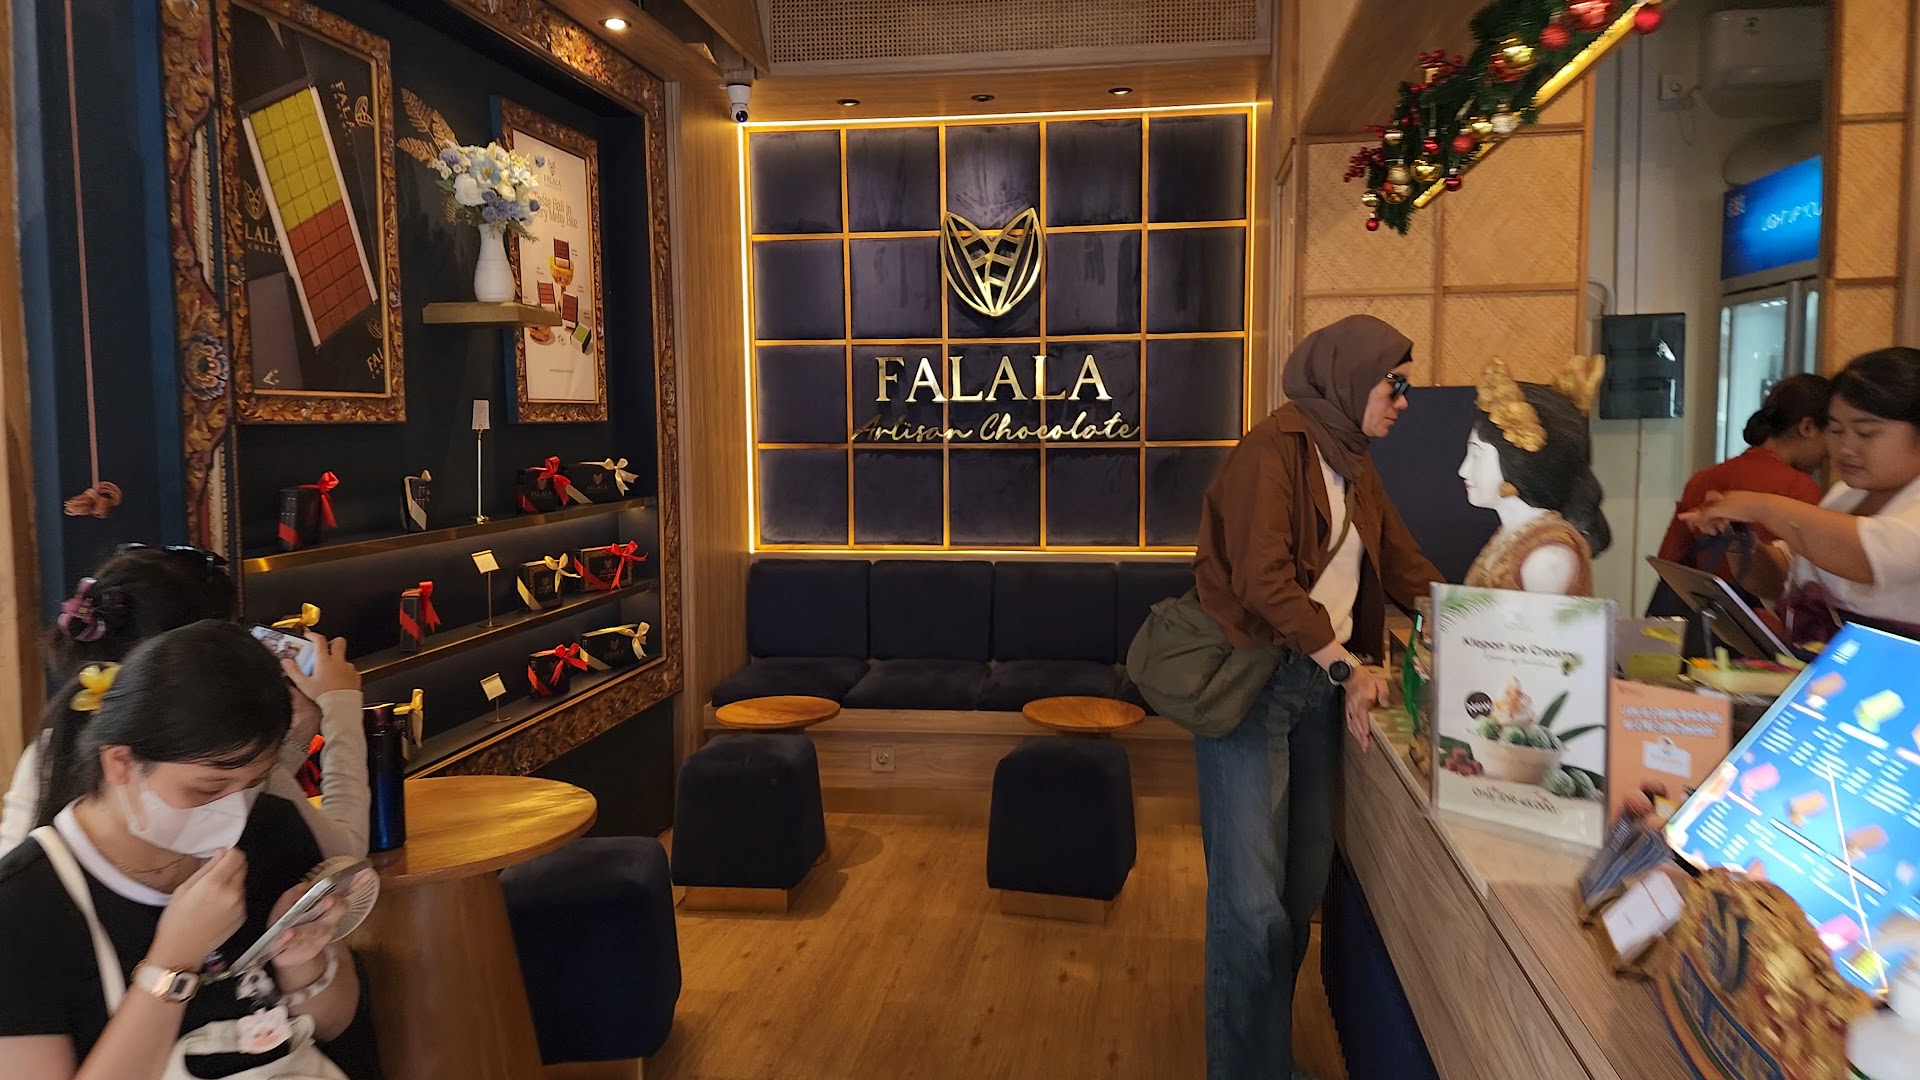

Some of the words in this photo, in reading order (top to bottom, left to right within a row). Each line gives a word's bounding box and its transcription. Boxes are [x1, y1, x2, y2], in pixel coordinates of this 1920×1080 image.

[875, 354, 1113, 402] FALALA
[852, 414, 973, 442] Artisan
[979, 411, 1139, 440] Chocolate
